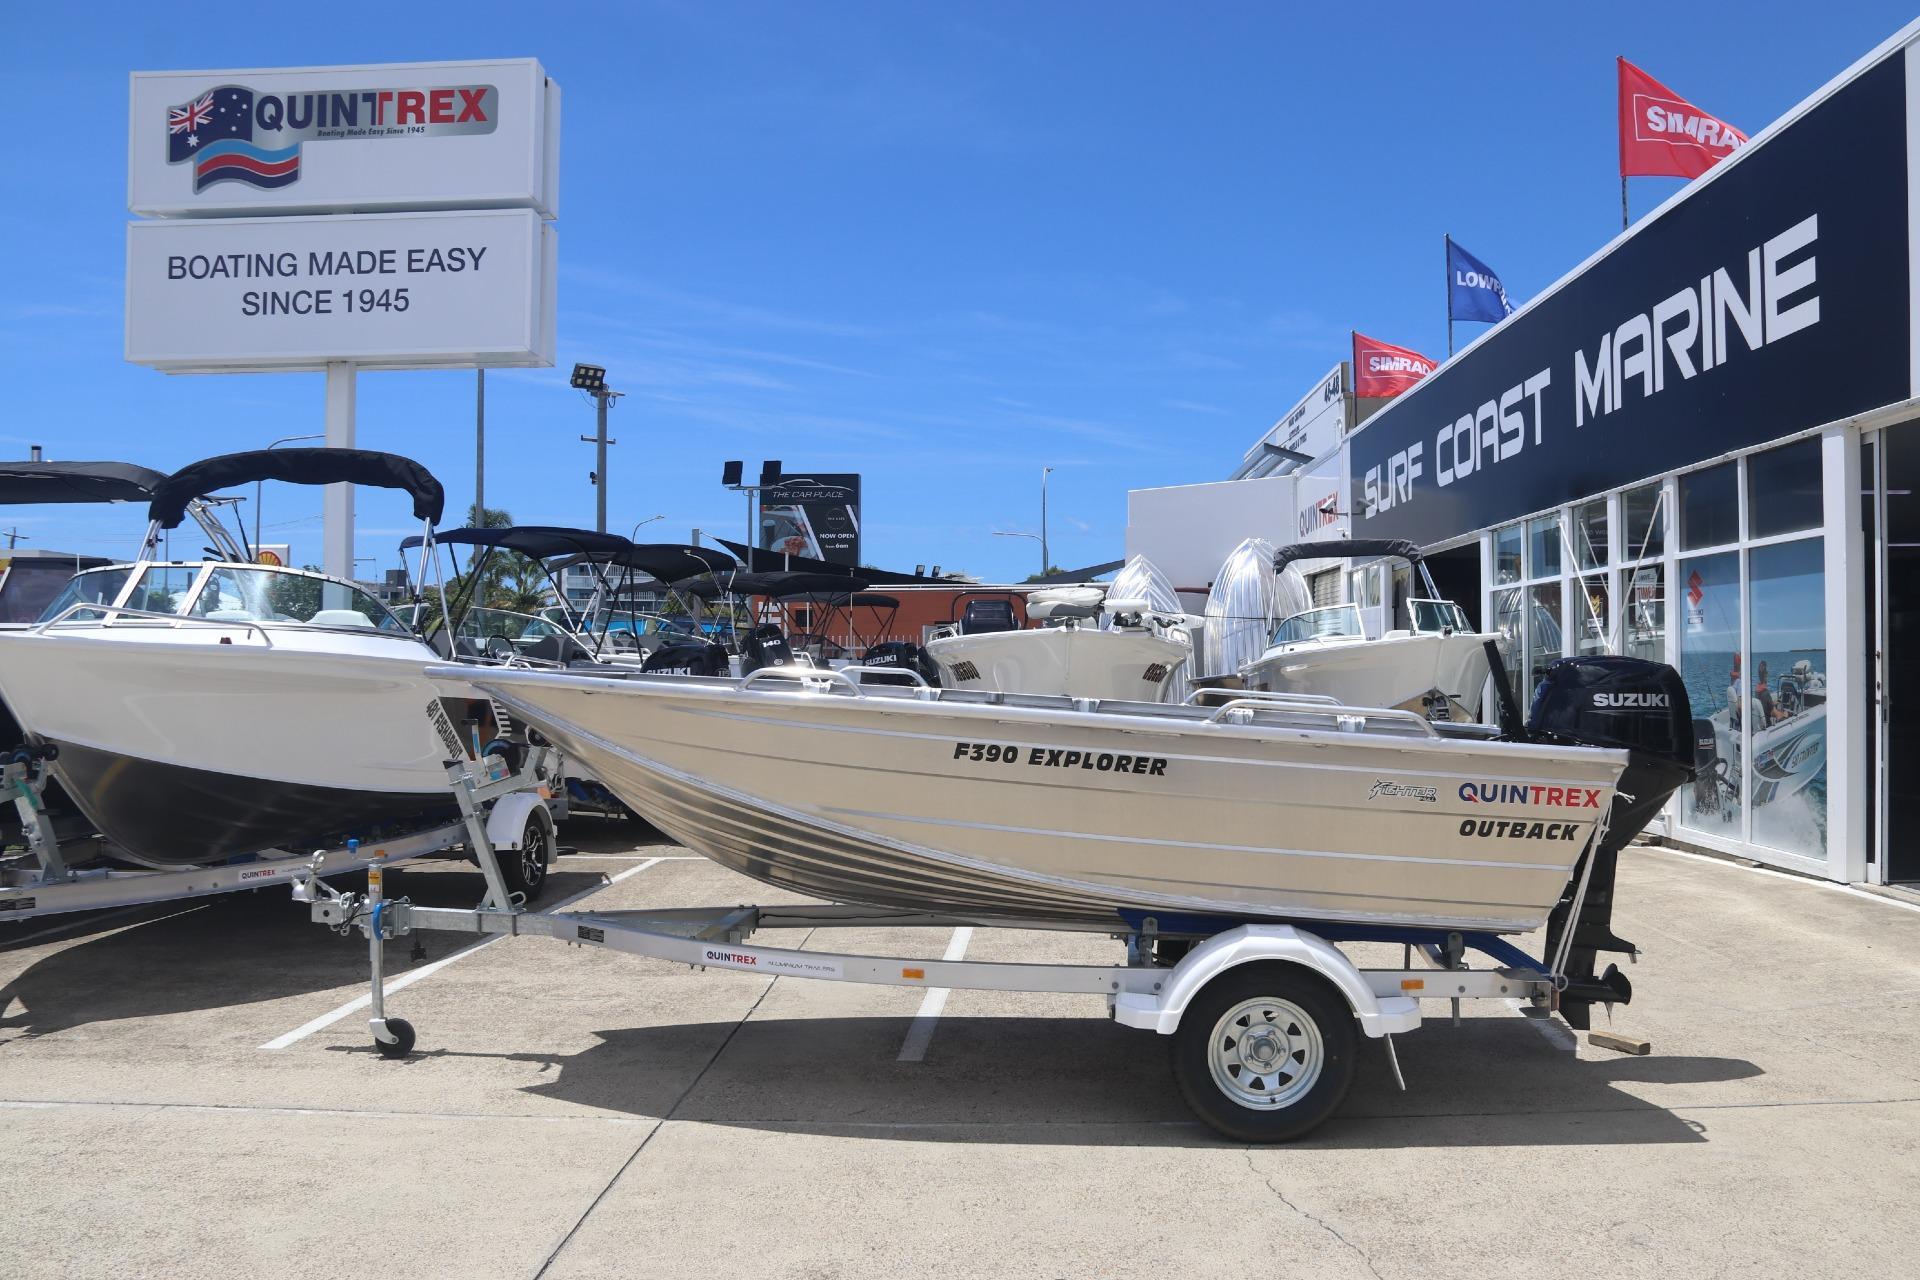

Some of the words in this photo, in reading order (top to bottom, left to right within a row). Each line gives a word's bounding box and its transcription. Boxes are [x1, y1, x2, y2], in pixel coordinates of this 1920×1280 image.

[255, 88, 488, 132] QUINTREX
[317, 130, 345, 138] Boating
[346, 128, 367, 136] Made
[368, 127, 385, 137] Easy
[385, 126, 404, 135] Since
[406, 126, 425, 134] 1945
[1646, 105, 1748, 151] SIMRA
[168, 252, 298, 280] BOATING
[308, 249, 397, 276] MADE
[407, 246, 488, 273] EASY
[241, 289, 333, 317] SINCE
[342, 287, 410, 314] 1945
[1364, 440, 1424, 520] SURF
[1436, 367, 1551, 488] COAST
[1574, 213, 1820, 428] MARINE
[1369, 356, 1433, 376] SIMRAD
[762, 639, 781, 648] 140
[865, 654, 898, 666] SUZUKI
[1593, 692, 1670, 707] SUZUKI
[953, 742, 1019, 764] F390
[1028, 747, 1168, 776] EXPLORER
[1368, 778, 1437, 799] FIGHTER
[1458, 782, 1601, 809] QUINTREX
[1459, 819, 1580, 841] OUTBACK
[241, 869, 275, 880] QUINTREX
[706, 950, 757, 966] QUINTREX
